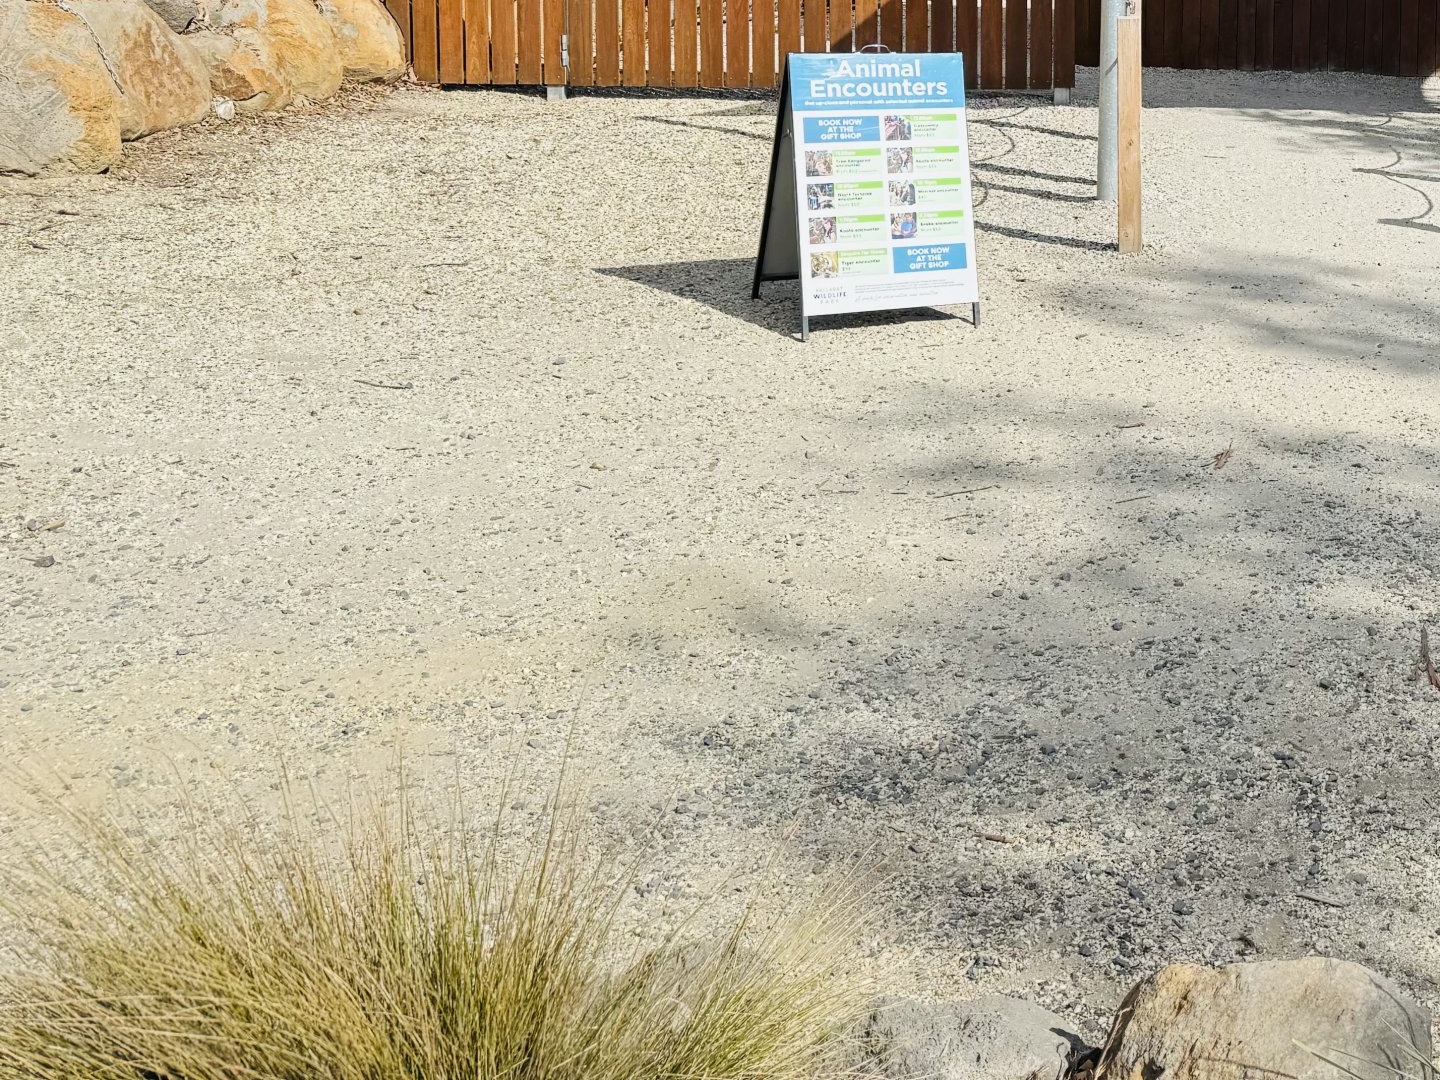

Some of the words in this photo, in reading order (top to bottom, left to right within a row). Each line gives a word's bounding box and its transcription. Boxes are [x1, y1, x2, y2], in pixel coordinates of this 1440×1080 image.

[834, 58, 921, 78] Animal
[810, 78, 948, 98] Encounters
[842, 118, 863, 126] NOW
[839, 132, 862, 140] SHOP
[907, 248, 929, 256] BOOK
[930, 246, 950, 254] NOW
[909, 262, 927, 270] GIFT
[813, 291, 848, 299] WILDLIFE
